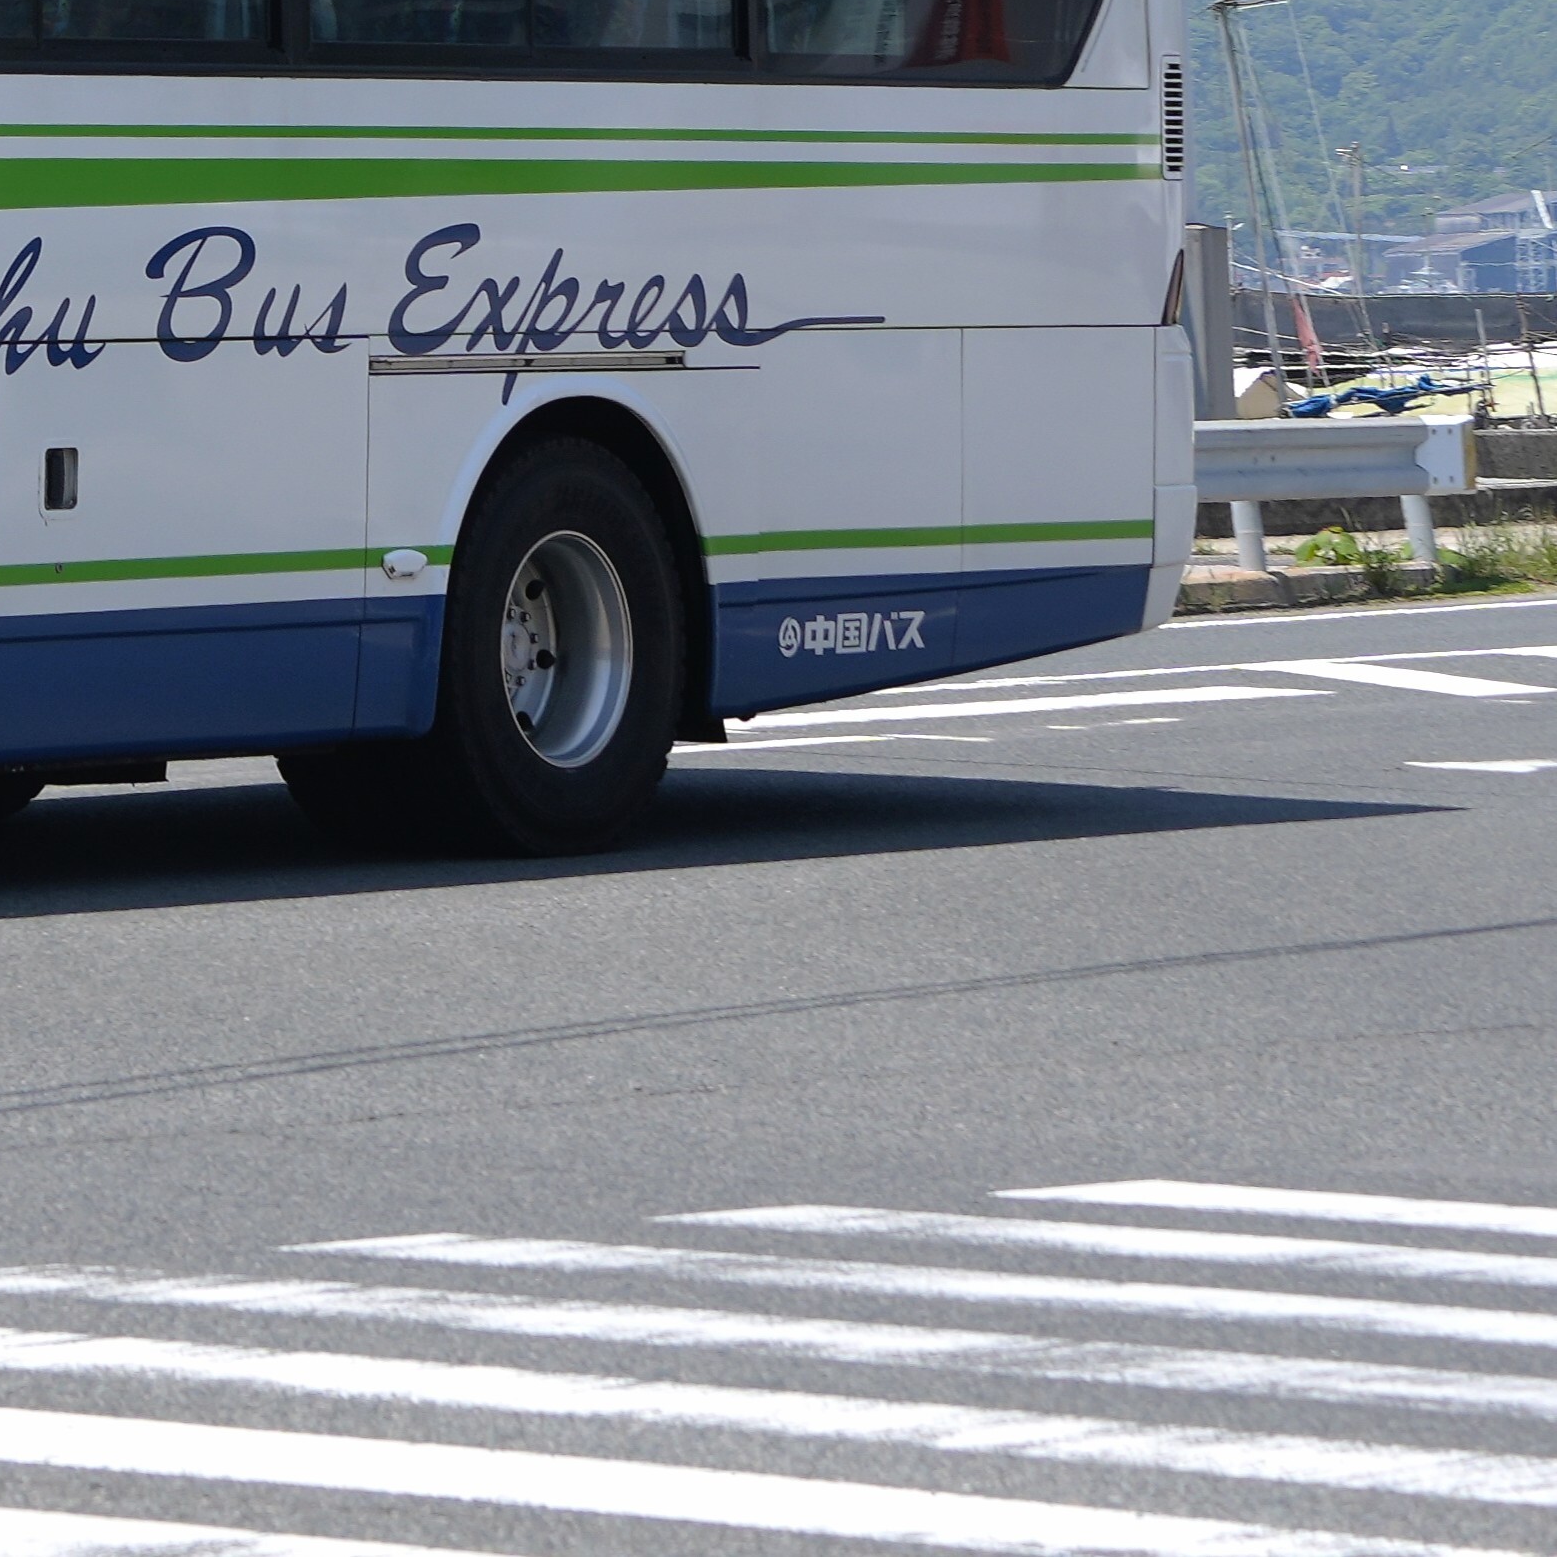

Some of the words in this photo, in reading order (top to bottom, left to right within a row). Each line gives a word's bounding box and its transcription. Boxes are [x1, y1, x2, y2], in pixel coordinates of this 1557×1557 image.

[145, 226, 355, 363] Bus
[386, 223, 885, 406] Express
[804, 610, 926, 656] 中国バス
